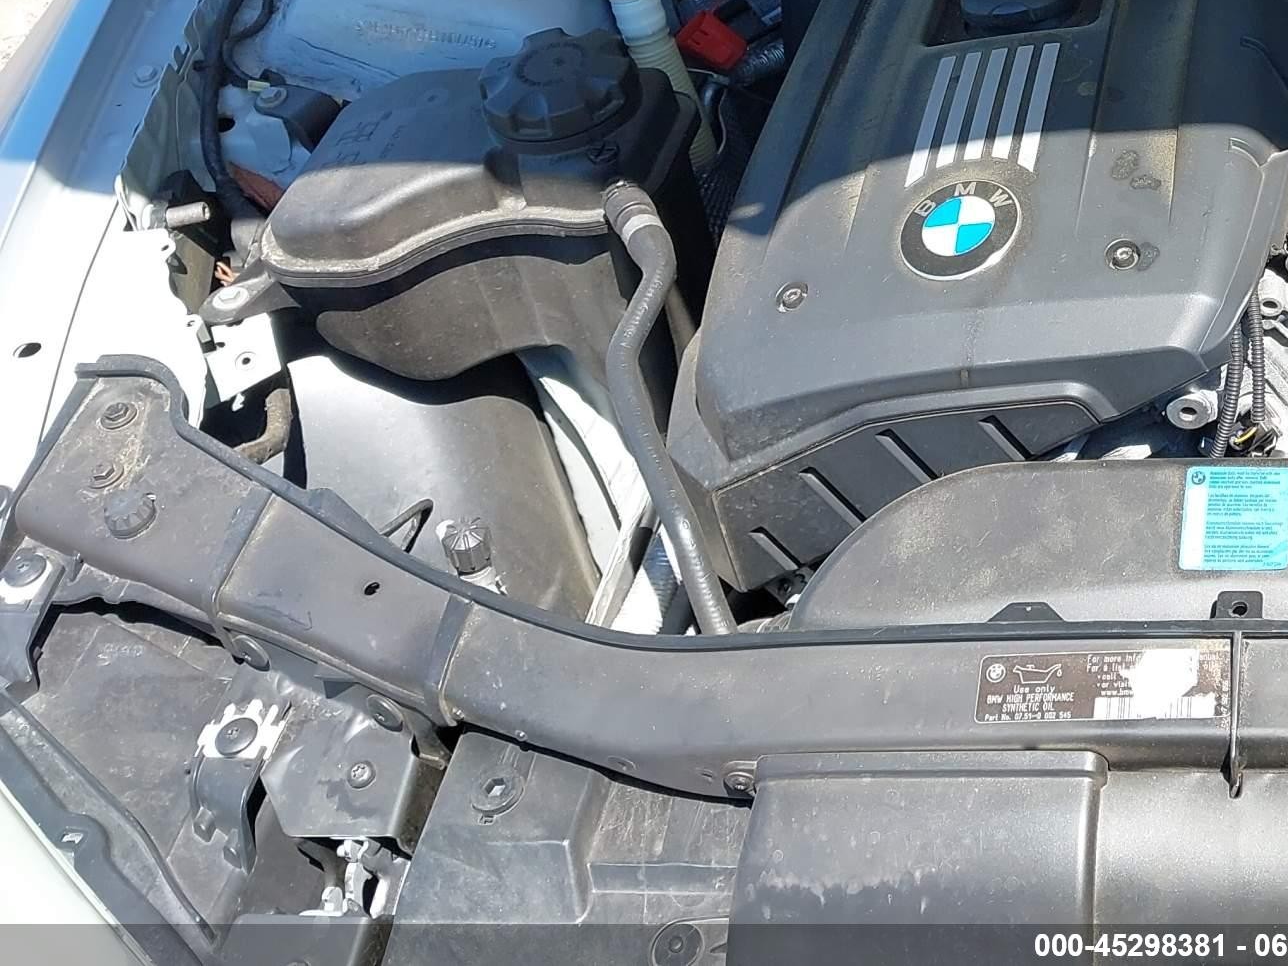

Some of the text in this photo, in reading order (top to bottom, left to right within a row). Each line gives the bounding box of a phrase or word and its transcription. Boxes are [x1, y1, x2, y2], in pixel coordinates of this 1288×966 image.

[914, 182, 1012, 217] BMW
[1087, 654, 1100, 663] For
[1104, 655, 1122, 663] more
[1086, 663, 1099, 672] For
[1013, 684, 1056, 694] Use only
[987, 692, 1075, 704] BMW HIGH PERFORMANCE
[1002, 702, 1055, 712] SYNTHETIC OIL
